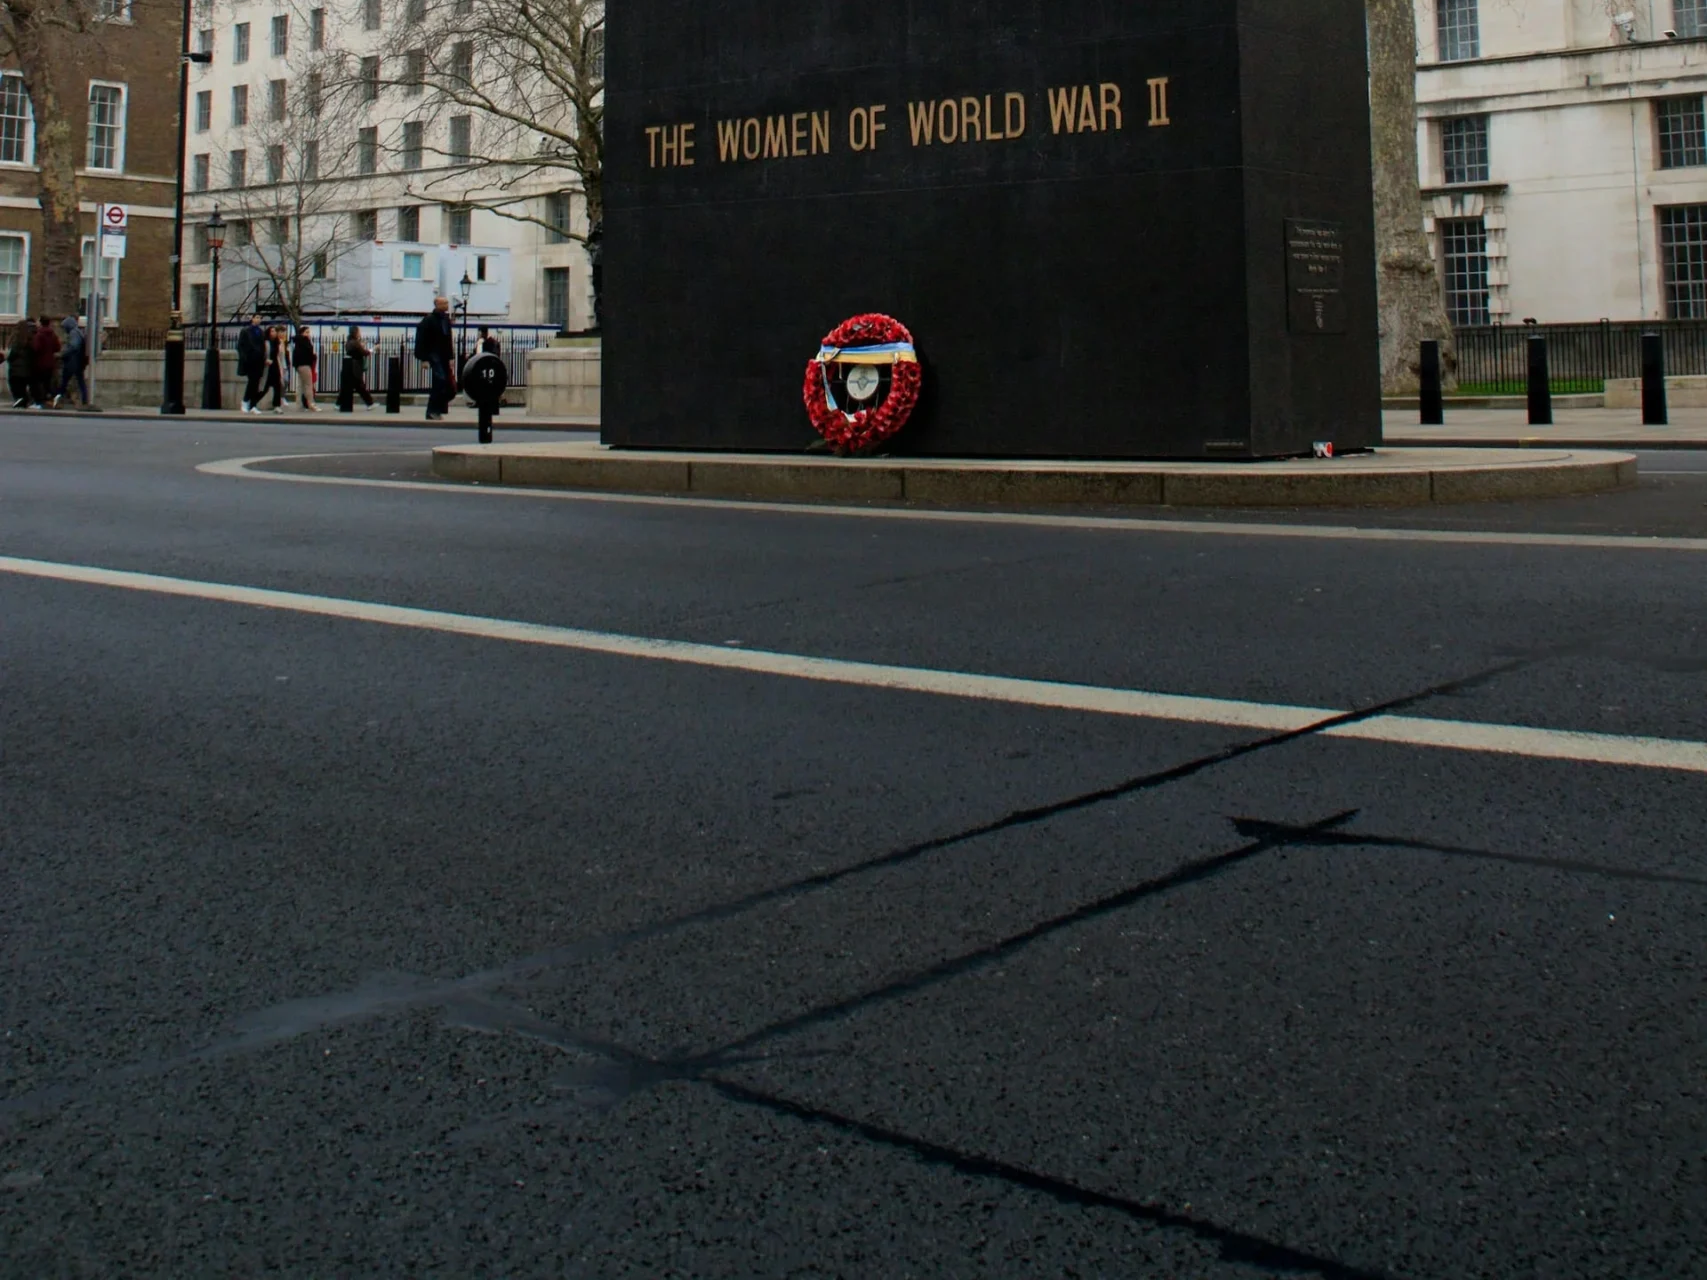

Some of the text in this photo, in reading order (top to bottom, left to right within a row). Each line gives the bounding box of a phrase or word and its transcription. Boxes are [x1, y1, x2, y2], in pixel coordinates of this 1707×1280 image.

[645, 76, 1171, 168] THE WOMEN OF WORLD WAR II
